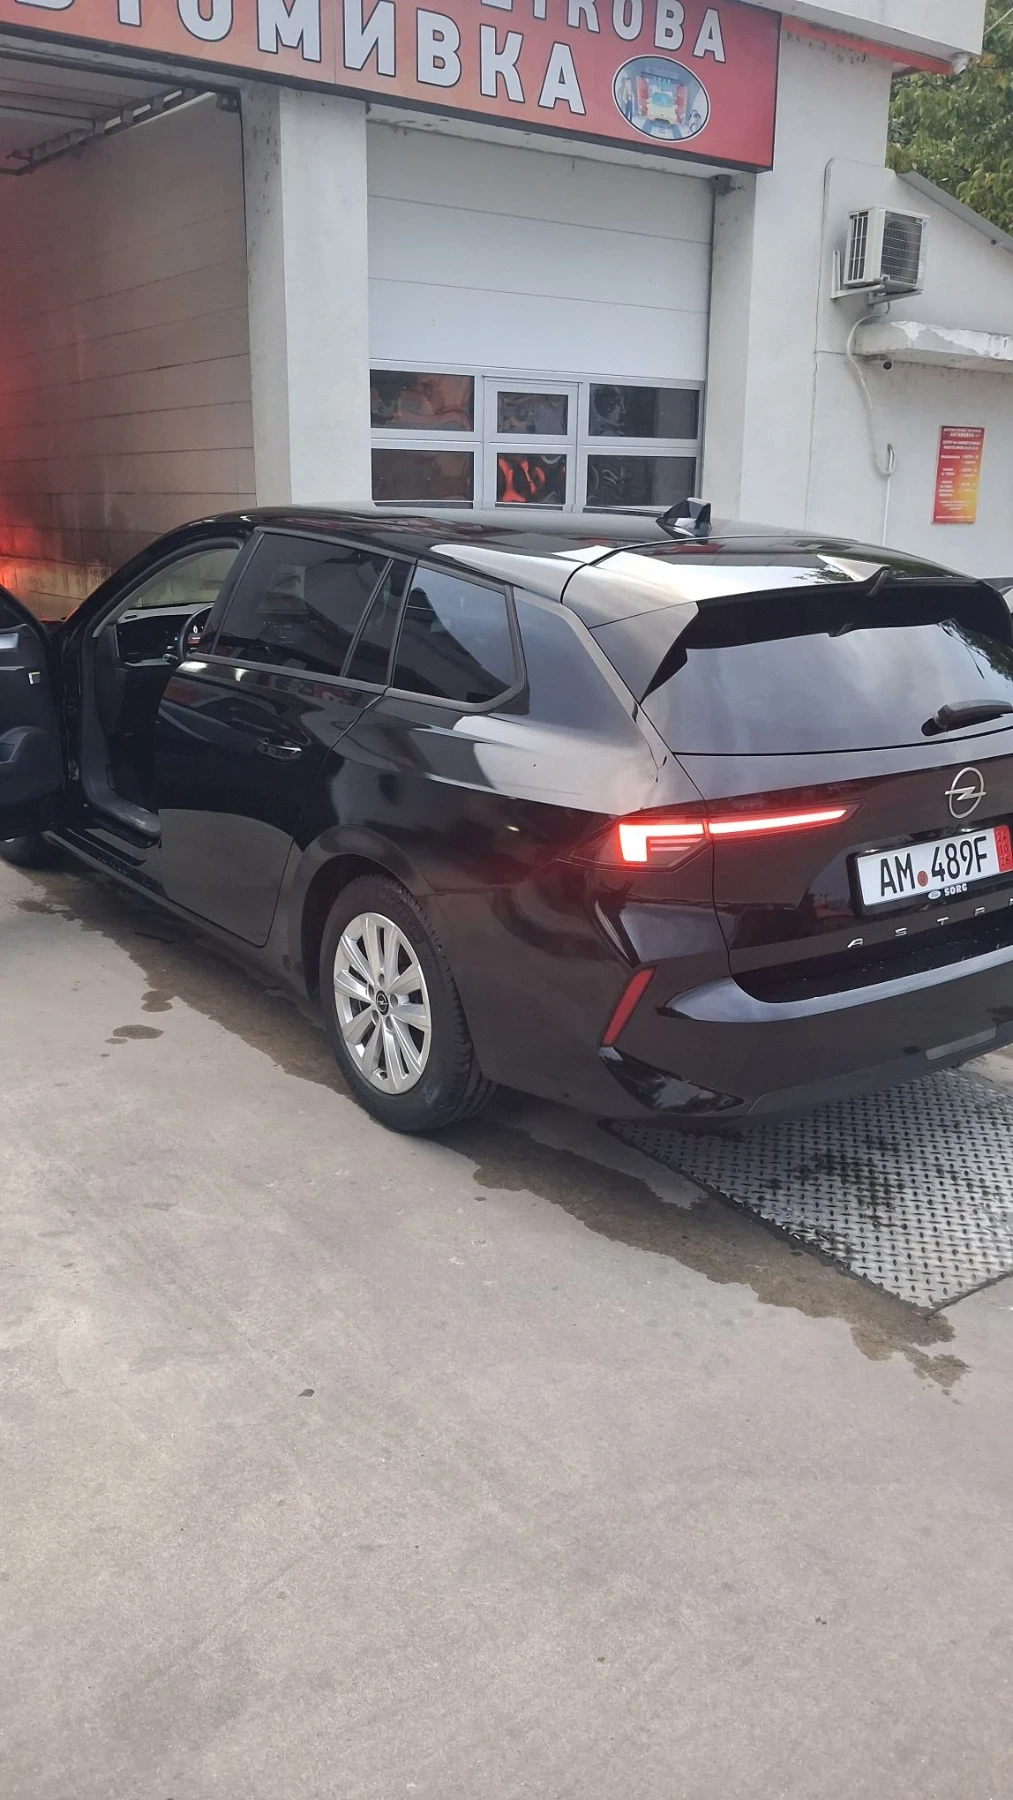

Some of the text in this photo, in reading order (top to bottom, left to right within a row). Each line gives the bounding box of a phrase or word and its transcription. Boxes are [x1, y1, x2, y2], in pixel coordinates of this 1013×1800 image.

[15, 0, 586, 115] ОМИВКА
[480, 0, 726, 63] КОВА
[880, 836, 988, 897] AM 489F
[944, 882, 968, 897] SORG
